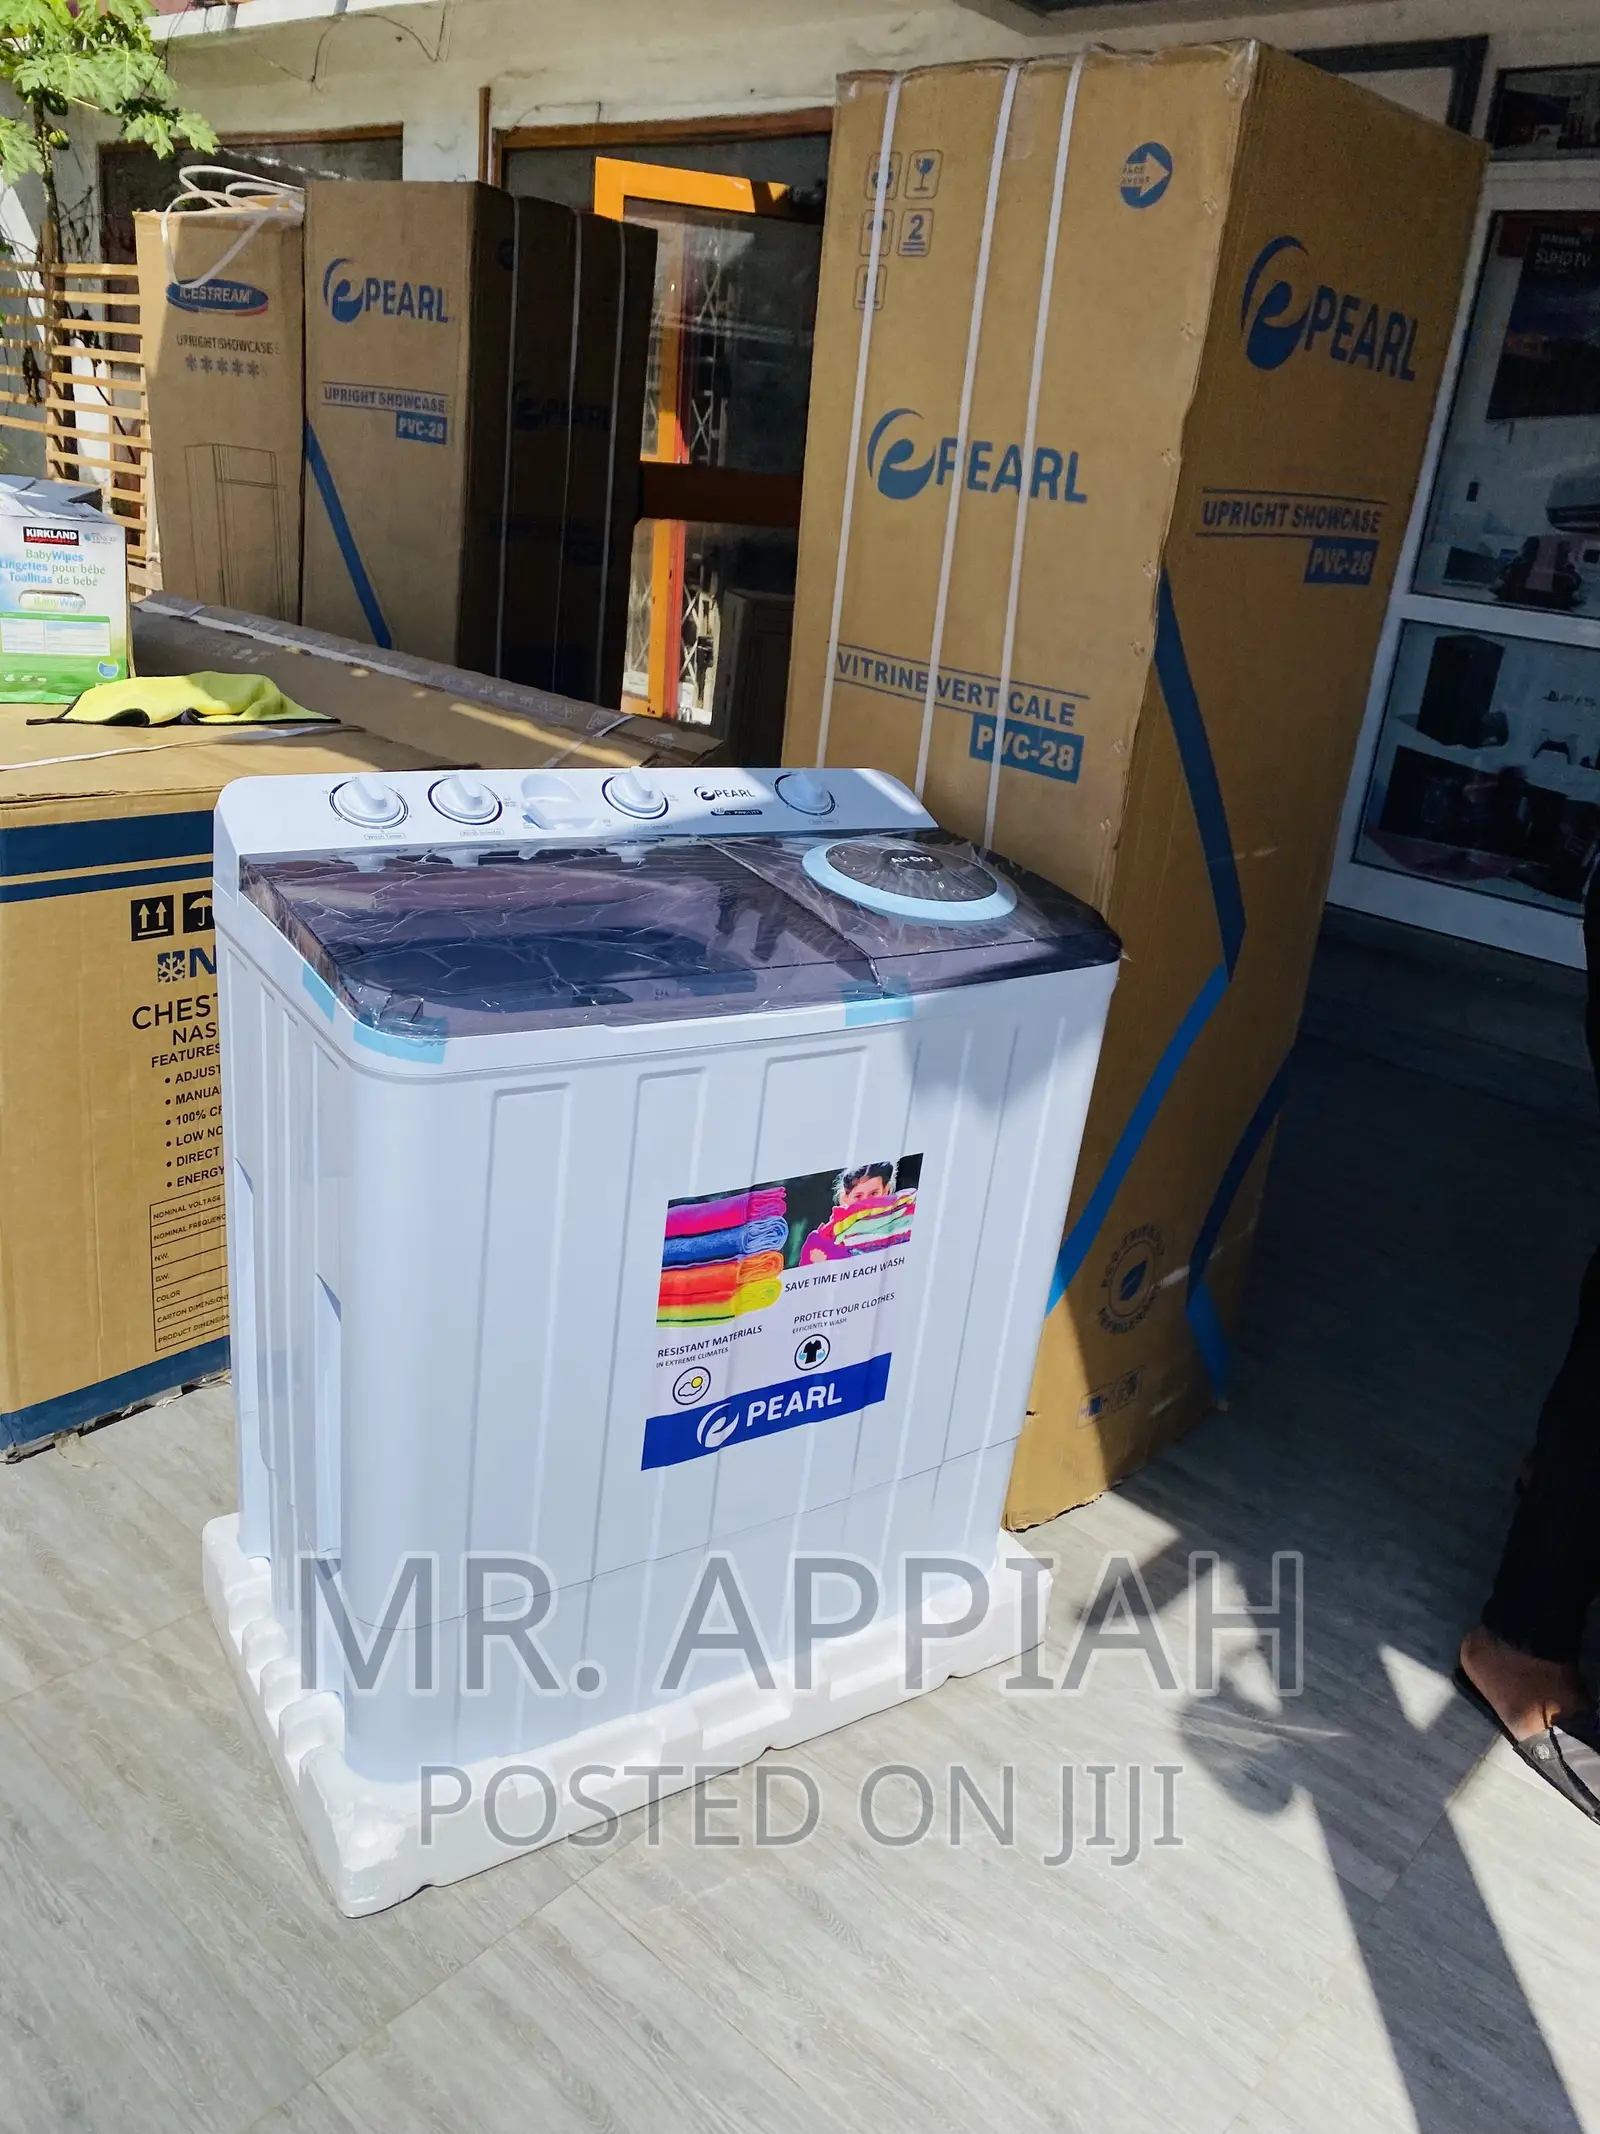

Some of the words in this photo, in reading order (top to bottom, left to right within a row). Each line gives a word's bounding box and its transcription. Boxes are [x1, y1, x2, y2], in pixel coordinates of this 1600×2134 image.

[908, 214, 925, 241] 2
[179, 285, 253, 305] ICESTREAM
[364, 277, 449, 324] PEARL
[176, 334, 217, 349] UPRIGHT
[1303, 284, 1418, 382] PEARL
[324, 386, 376, 406] UPRIGHT
[378, 391, 446, 413] SHOWCASE
[398, 417, 445, 438] PVC-28
[935, 436, 1088, 504] PEARL
[1203, 500, 1290, 528] UPRIGHT
[1291, 504, 1383, 533] SHOWCASE
[25, 527, 77, 540] KIRKLAND
[0, 559, 48, 573] Lingettes
[52, 565, 76, 577] pour
[1310, 547, 1373, 575] PVC-28
[9, 571, 52, 585] Toallitas
[56, 575, 69, 585] de
[837, 651, 929, 694] VITRINE
[935, 674, 1076, 727] VERTCALE
[714, 789, 756, 798] PEARL
[890, 856, 909, 864] Air
[909, 855, 933, 864] Dry
[132, 993, 218, 1030] CHES
[173, 1022, 217, 1046] NAS
[176, 1109, 207, 1126] 100%
[176, 1130, 205, 1147] LOW
[176, 1146, 221, 1167] DIRECT
[177, 1165, 225, 1187] ENERGY
[153, 1205, 188, 1220] NOMINAL
[188, 1194, 221, 1209] VOLTAGE
[153, 1225, 188, 1241] NOMINAL
[784, 1278, 810, 1293] SAVE
[812, 1273, 838, 1287] TIME
[839, 1270, 851, 1282] IN
[852, 1265, 878, 1279] EACH
[879, 1256, 906, 1272] WASH
[156, 1289, 181, 1303] COLOR
[157, 1308, 187, 1324] CARTON
[793, 1308, 834, 1325] PROTECT
[835, 1303, 860, 1316] YOUR
[861, 1292, 896, 1310] CLOTHES
[158, 1326, 192, 1344] PRODUCT
[792, 1320, 828, 1335] EFFICIENTLY
[829, 1317, 848, 1327] WASH
[657, 1340, 710, 1358] RESISTANT
[712, 1324, 763, 1347] MATERIALS
[656, 1360, 664, 1369] IN
[665, 1354, 697, 1368] EXTREME
[697, 1346, 730, 1361] CLIMATES
[746, 1382, 843, 1427] PEARL
